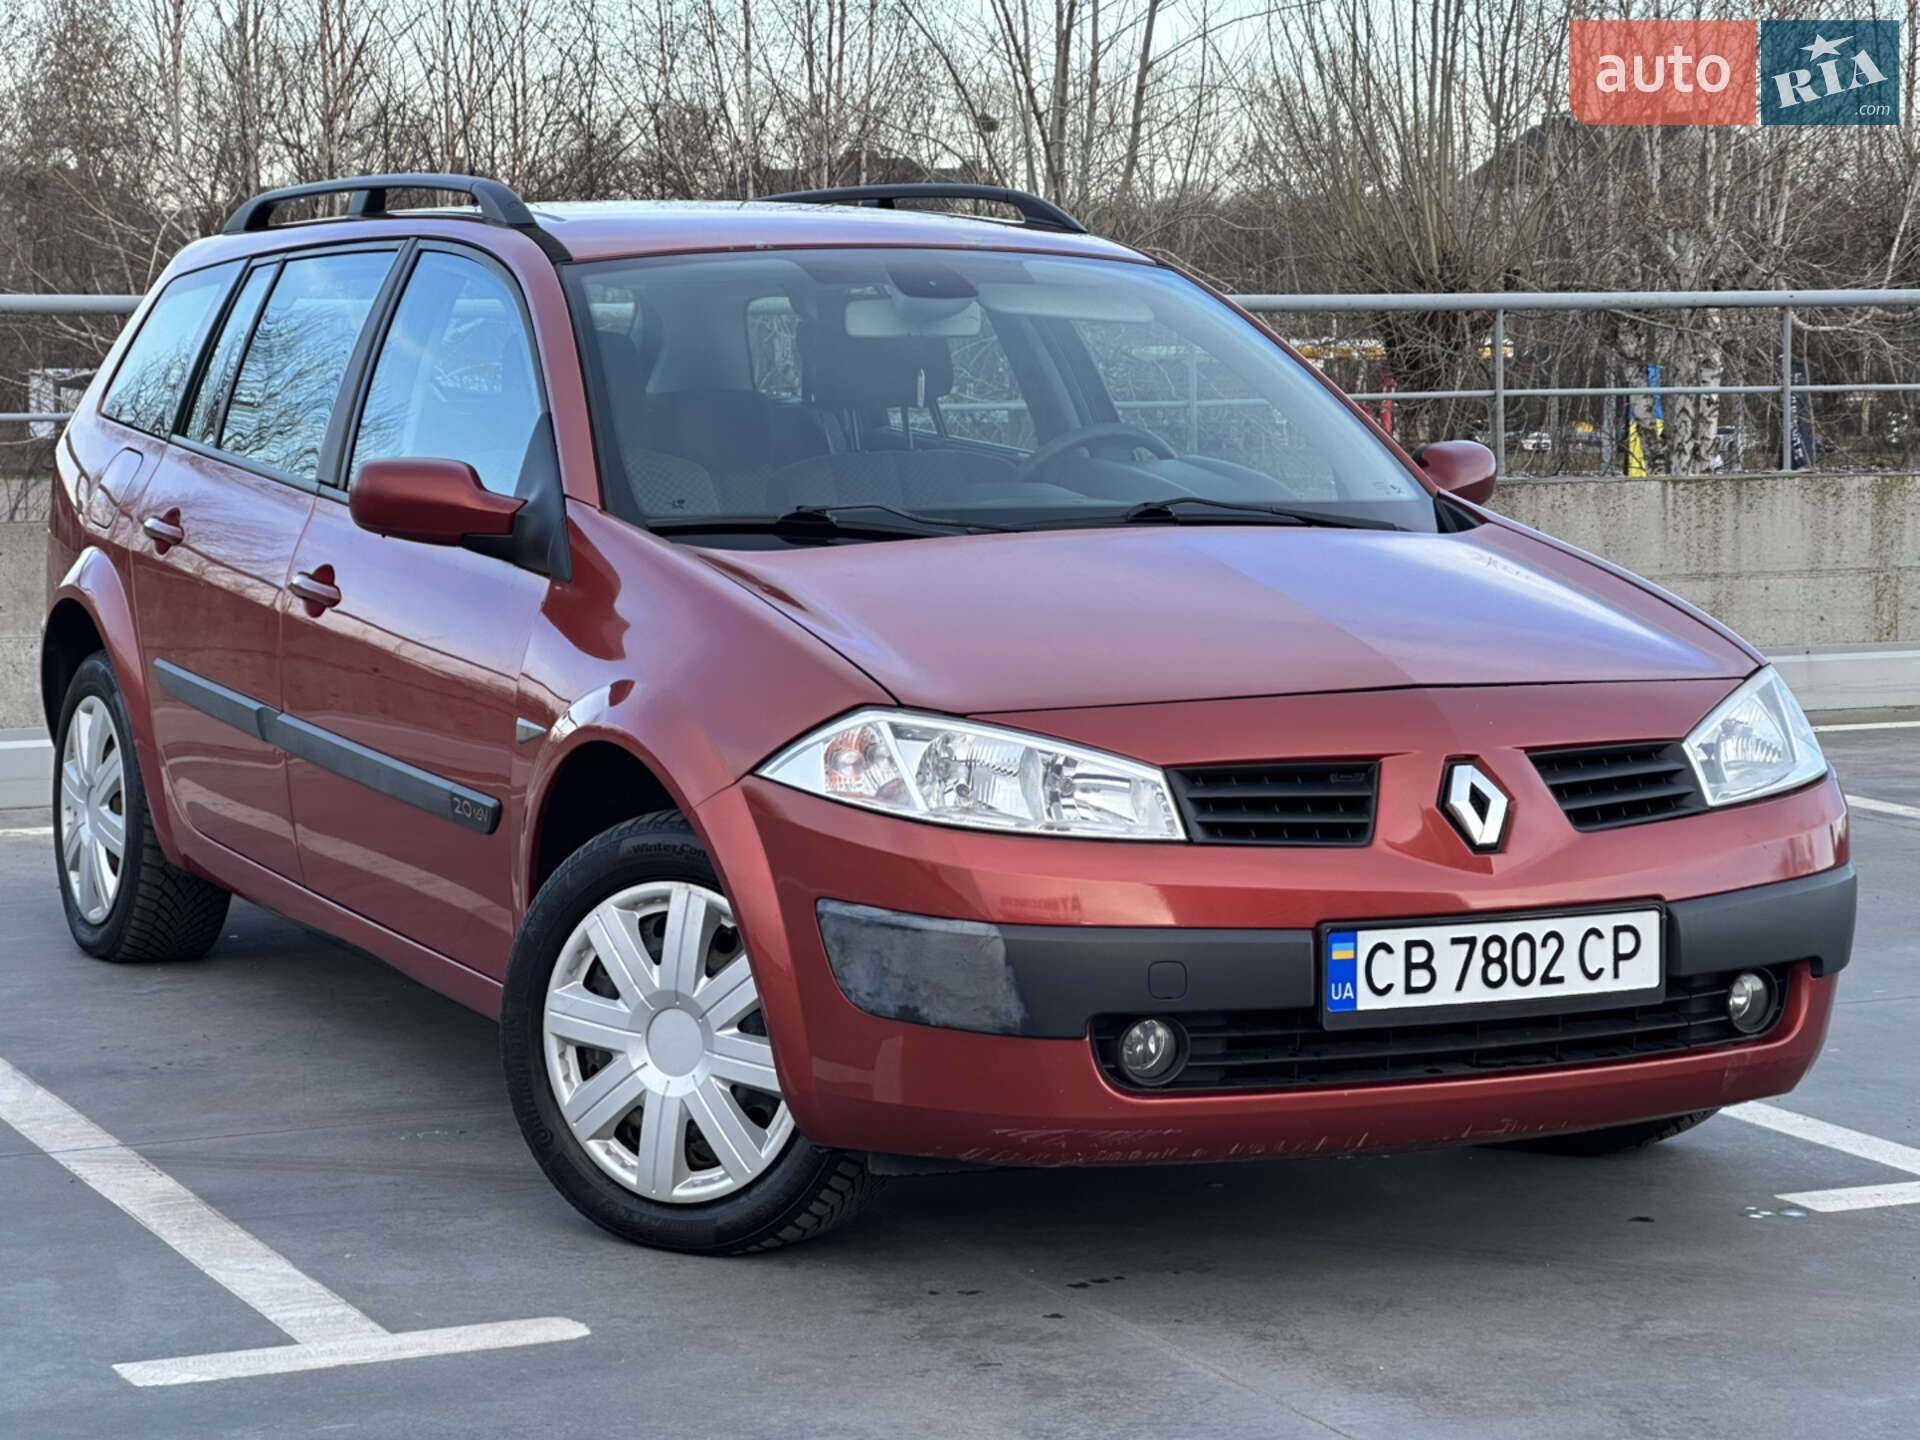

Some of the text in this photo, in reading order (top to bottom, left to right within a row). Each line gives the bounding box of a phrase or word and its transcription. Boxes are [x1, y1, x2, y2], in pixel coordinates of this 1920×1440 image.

[1364, 924, 1641, 997] CB 7802 CP
[1331, 982, 1355, 1000] UA
